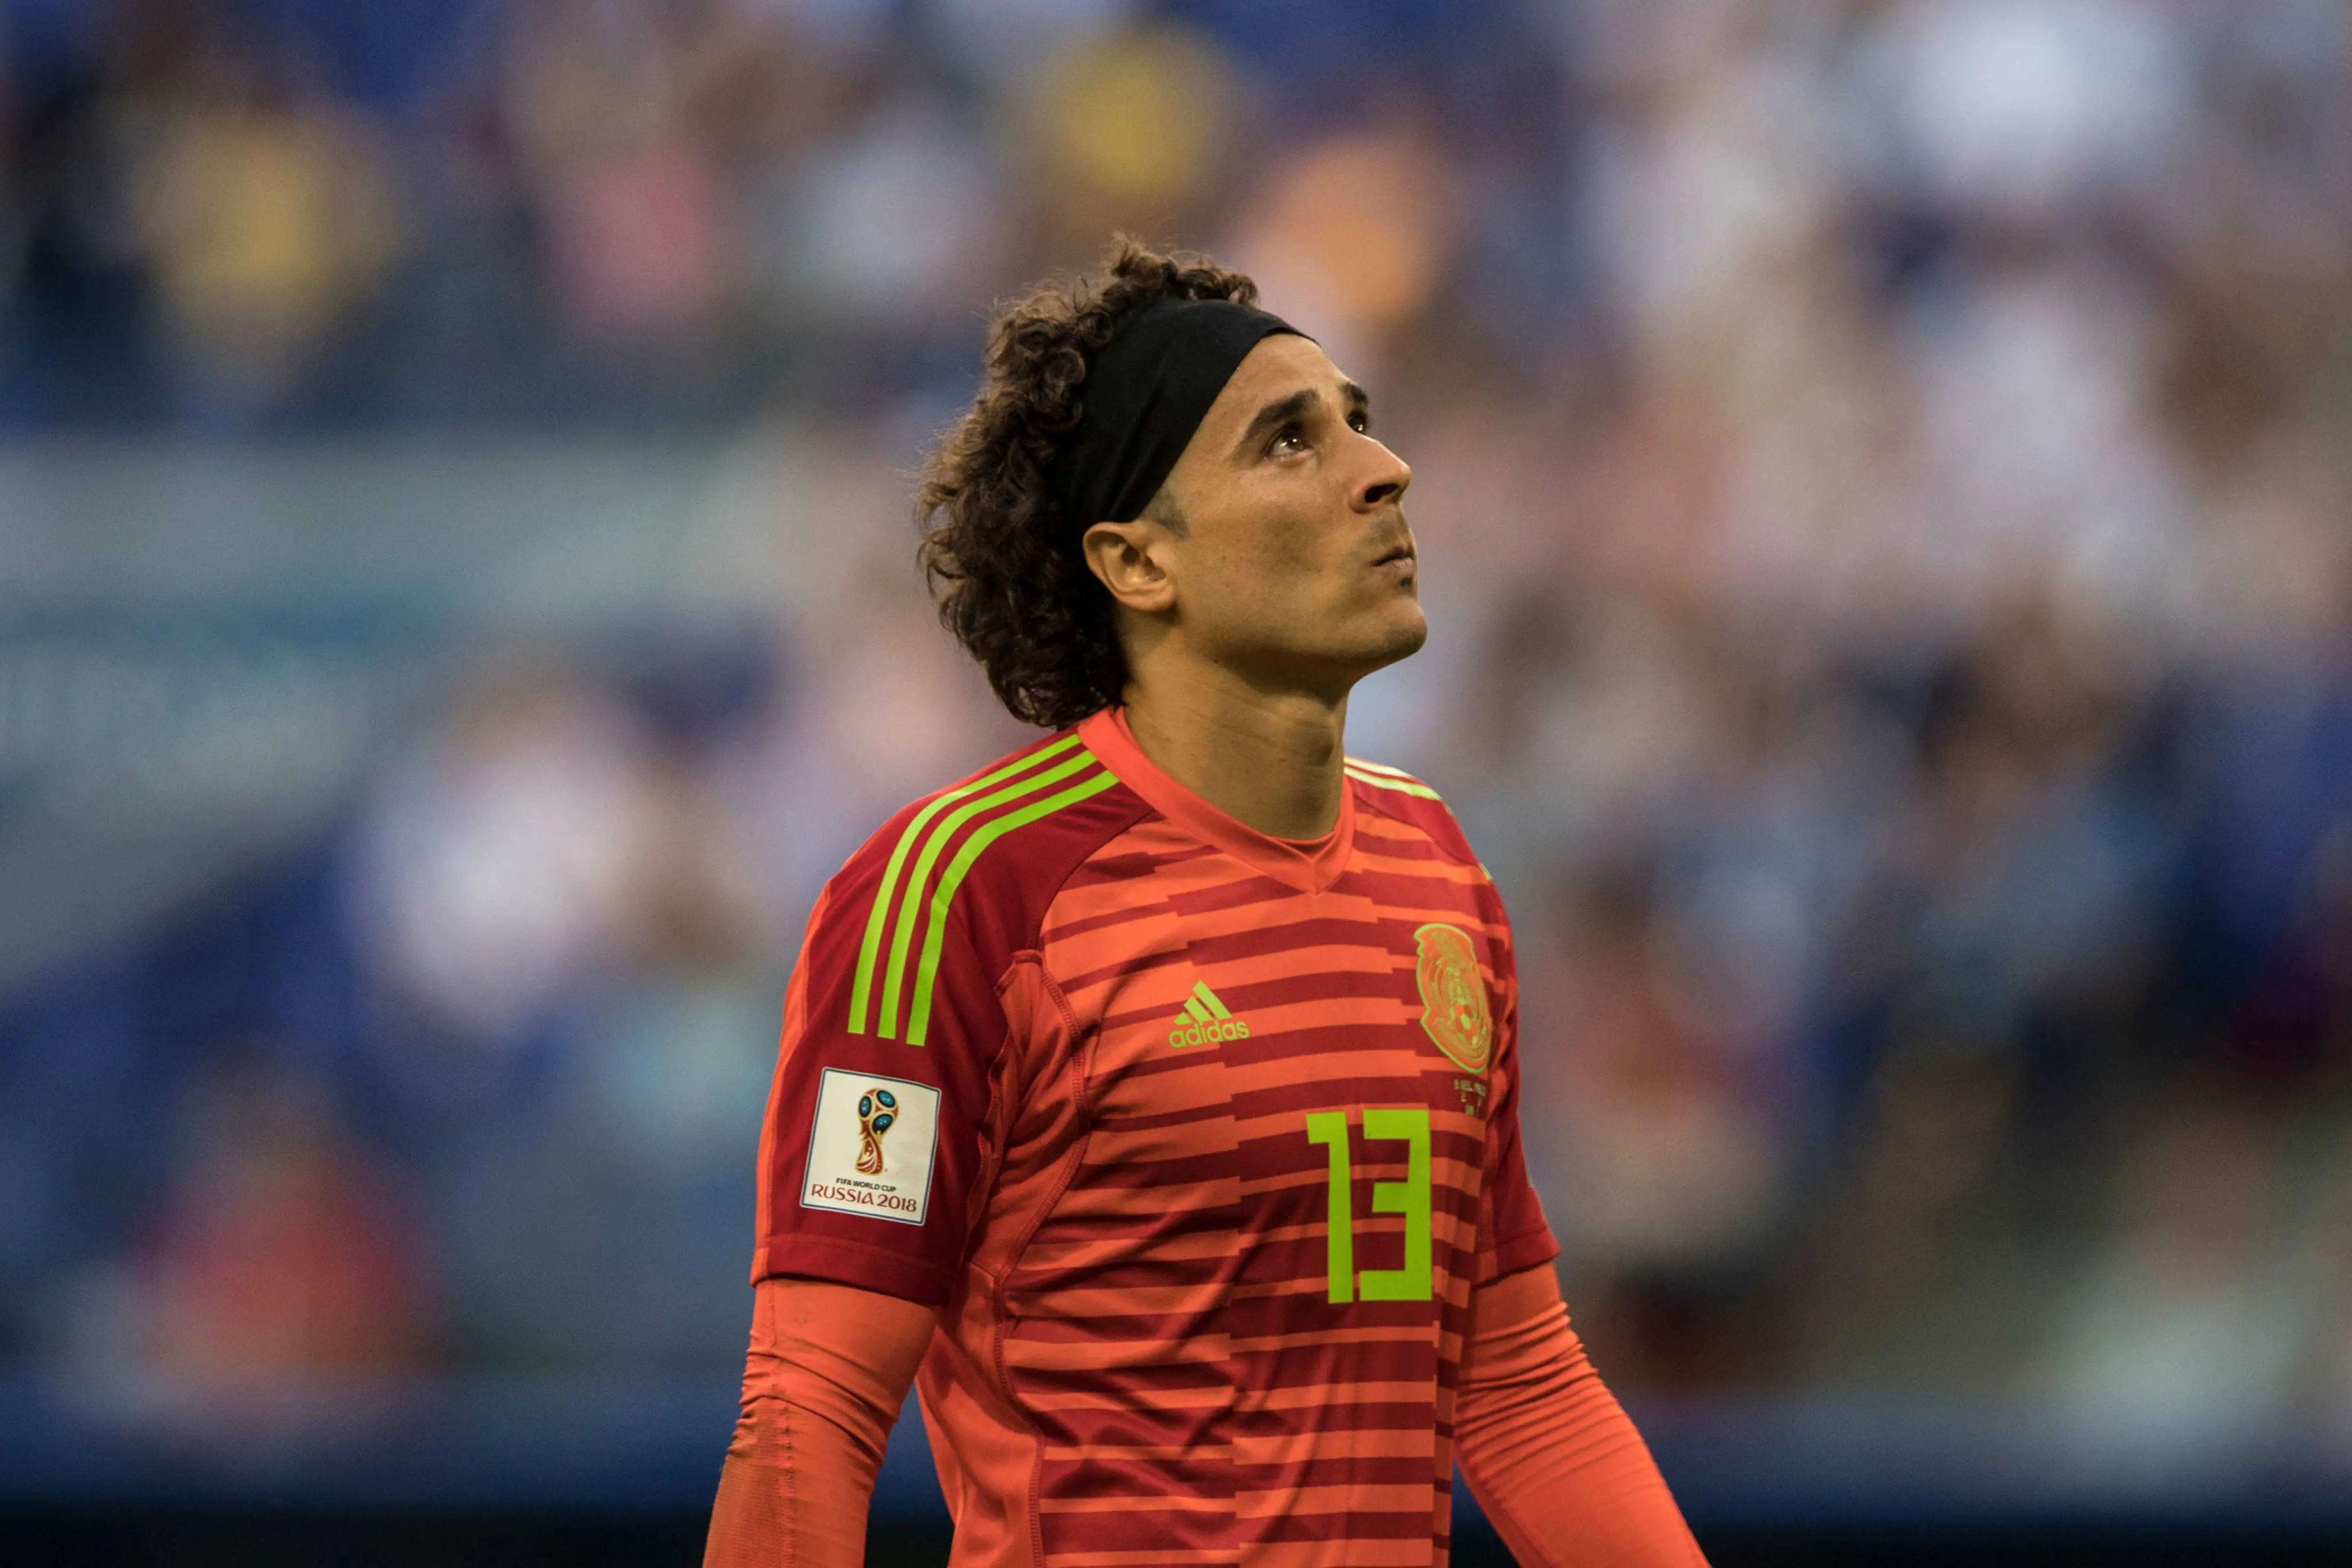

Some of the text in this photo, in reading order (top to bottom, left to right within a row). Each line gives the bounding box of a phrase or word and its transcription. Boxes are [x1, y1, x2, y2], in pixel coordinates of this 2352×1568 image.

[1169, 1020, 1250, 1048] adidas
[811, 1184, 917, 1212] RUSSIA 2018
[836, 1177, 896, 1192] FIFA WORLD CUP
[1306, 1109, 1432, 1304] 13
